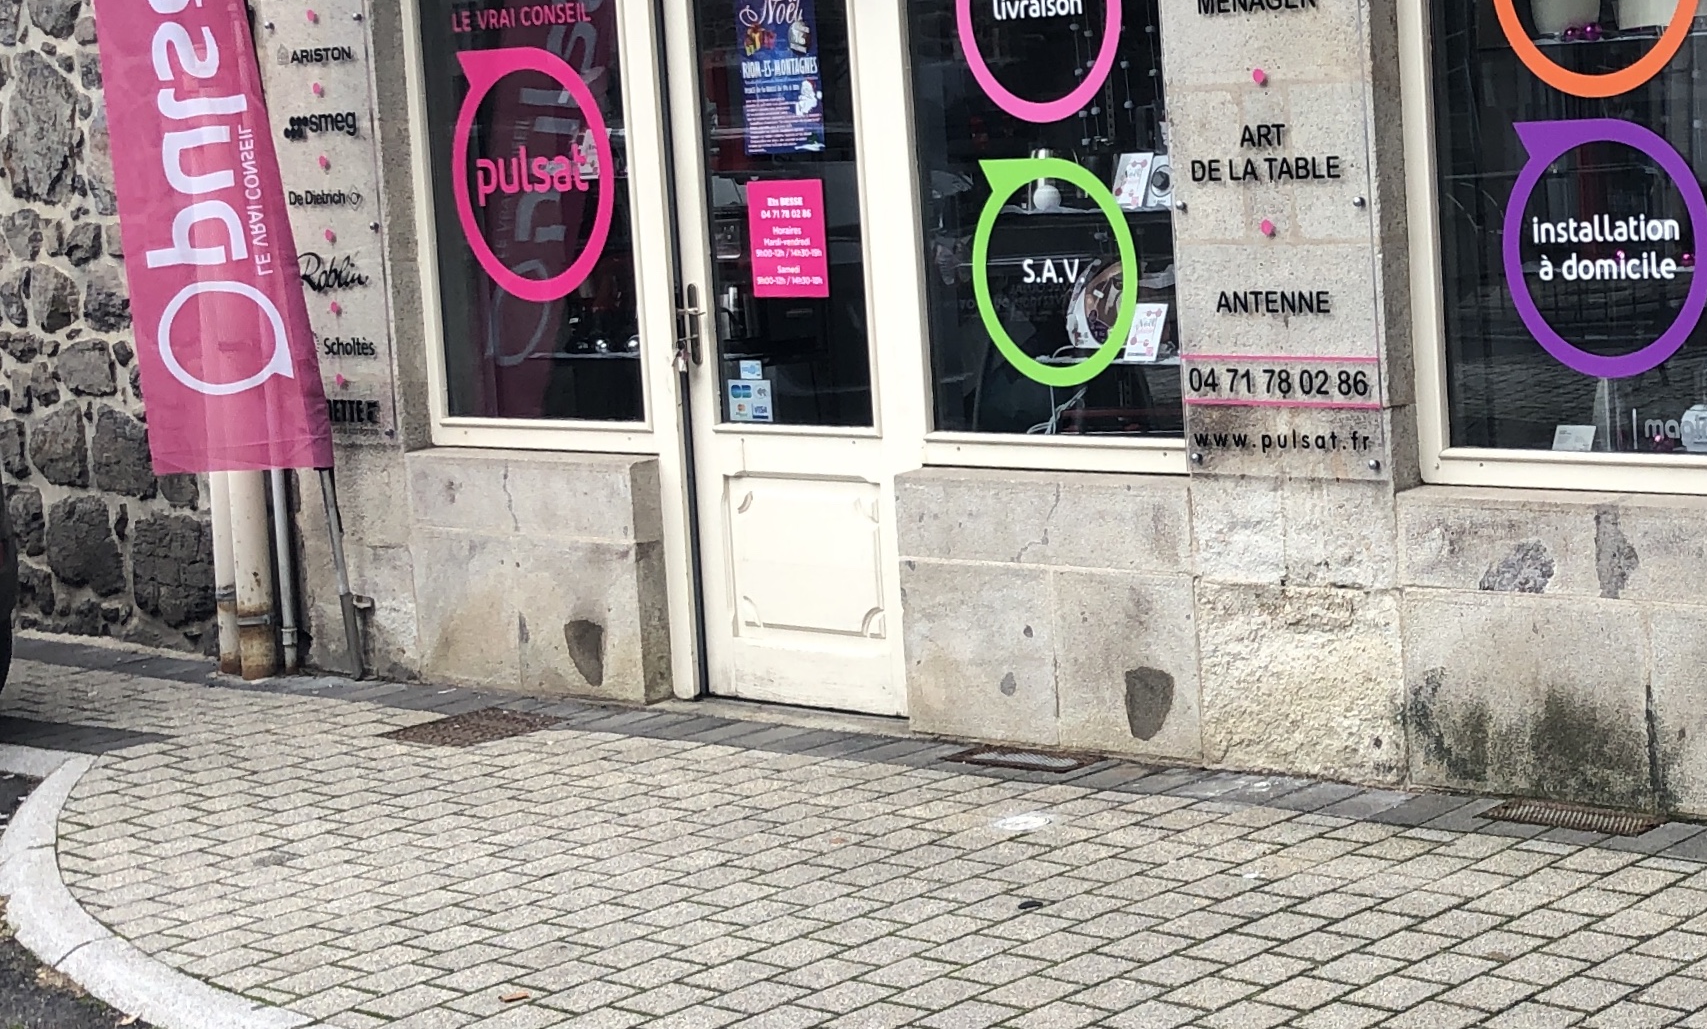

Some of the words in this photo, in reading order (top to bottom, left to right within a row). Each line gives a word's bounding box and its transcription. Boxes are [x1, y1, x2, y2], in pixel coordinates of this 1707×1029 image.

[452, 11, 472, 33] LE
[477, 6, 516, 31] VRAI
[520, 1, 591, 27] CONSEIL
[290, 46, 352, 64] ARISTON
[308, 112, 357, 136] smeg
[1240, 123, 1286, 148] ART
[476, 142, 589, 207] pulsat
[1191, 159, 1222, 182] DE
[1229, 159, 1258, 181] LA
[1264, 156, 1341, 180] TABLE
[289, 191, 303, 206] De
[305, 190, 346, 206] Dietrich
[761, 210, 771, 219] 04
[772, 210, 780, 219] 71
[791, 209, 801, 219] 02
[1533, 213, 1680, 244] installation
[297, 251, 369, 292] Roblin
[1022, 258, 1086, 284] S.A.V.
[1539, 255, 1554, 281] à
[1561, 252, 1677, 281] domicile
[1216, 291, 1331, 314] ANTENNE
[324, 337, 376, 356] Scholtès
[1189, 367, 1218, 393] 04
[1226, 368, 1251, 393] 71
[1262, 369, 1292, 395] 78
[1299, 369, 1329, 395] 02
[1337, 370, 1368, 396] 86
[1193, 428, 1370, 453] www.pulsat.fr
